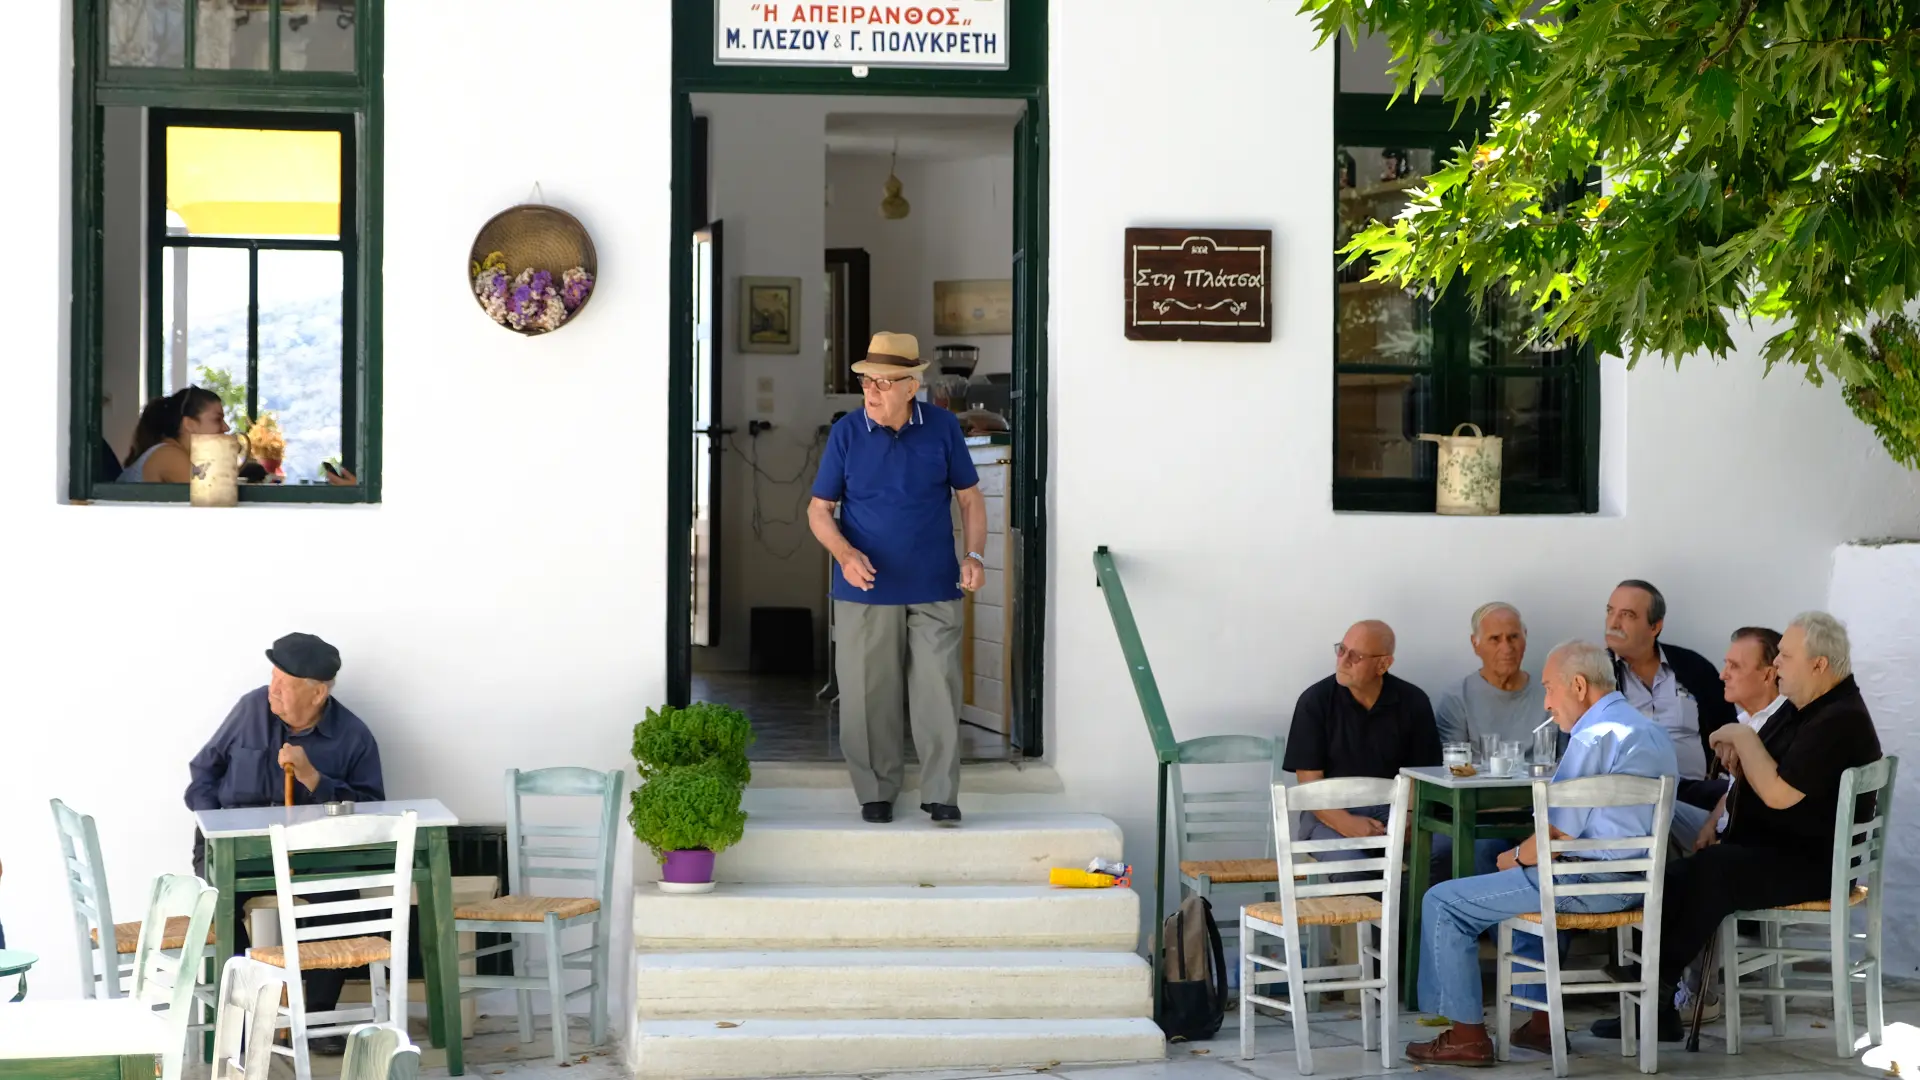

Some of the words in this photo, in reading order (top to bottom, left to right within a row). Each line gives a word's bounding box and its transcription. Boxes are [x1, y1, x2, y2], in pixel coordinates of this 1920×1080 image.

[726, 27, 746, 49] Μ.
[753, 28, 829, 50] ΓΛΕΖΟΥ
[834, 36, 843, 49] &
[850, 30, 863, 50] Γ.
[872, 31, 996, 54] ΠΟΛΥΚΡΕΤΗ
[1136, 268, 1175, 291] Στη
[1184, 268, 1261, 288] Πλάτσα
